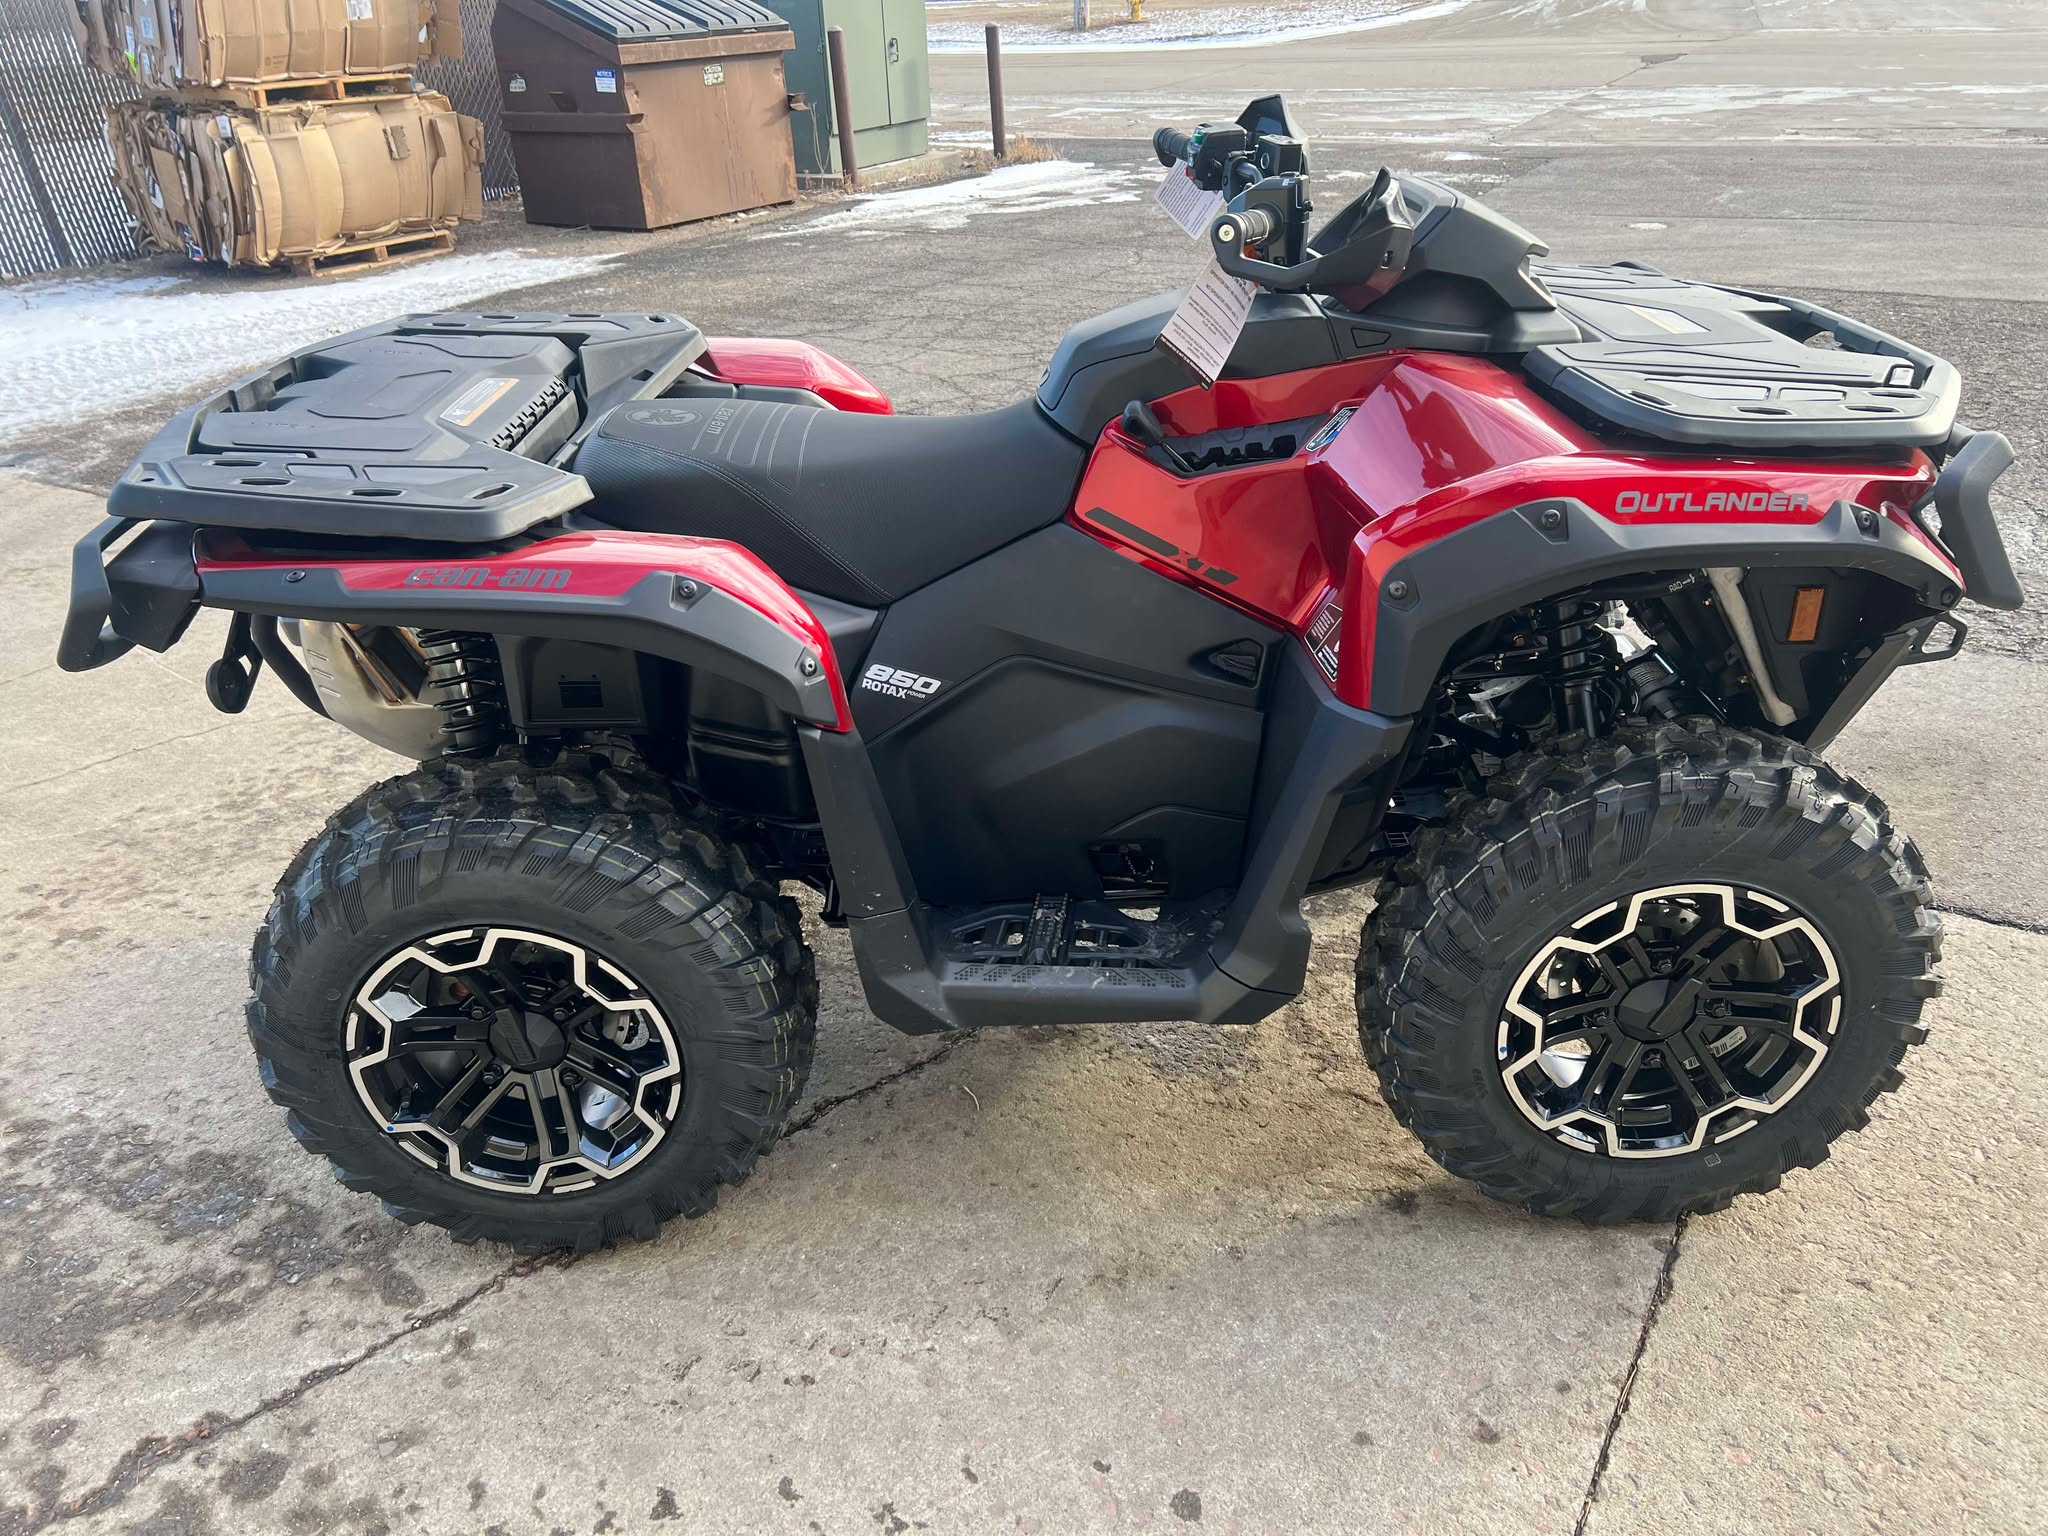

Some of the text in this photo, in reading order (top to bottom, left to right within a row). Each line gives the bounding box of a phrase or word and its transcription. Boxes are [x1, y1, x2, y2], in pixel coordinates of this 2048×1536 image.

[596, 70, 613, 78] NOTICE
[1615, 490, 1809, 513] OUTLANDER
[403, 567, 572, 589] can-am
[861, 677, 926, 699] ROTAX POWER
[864, 663, 942, 694] 850
